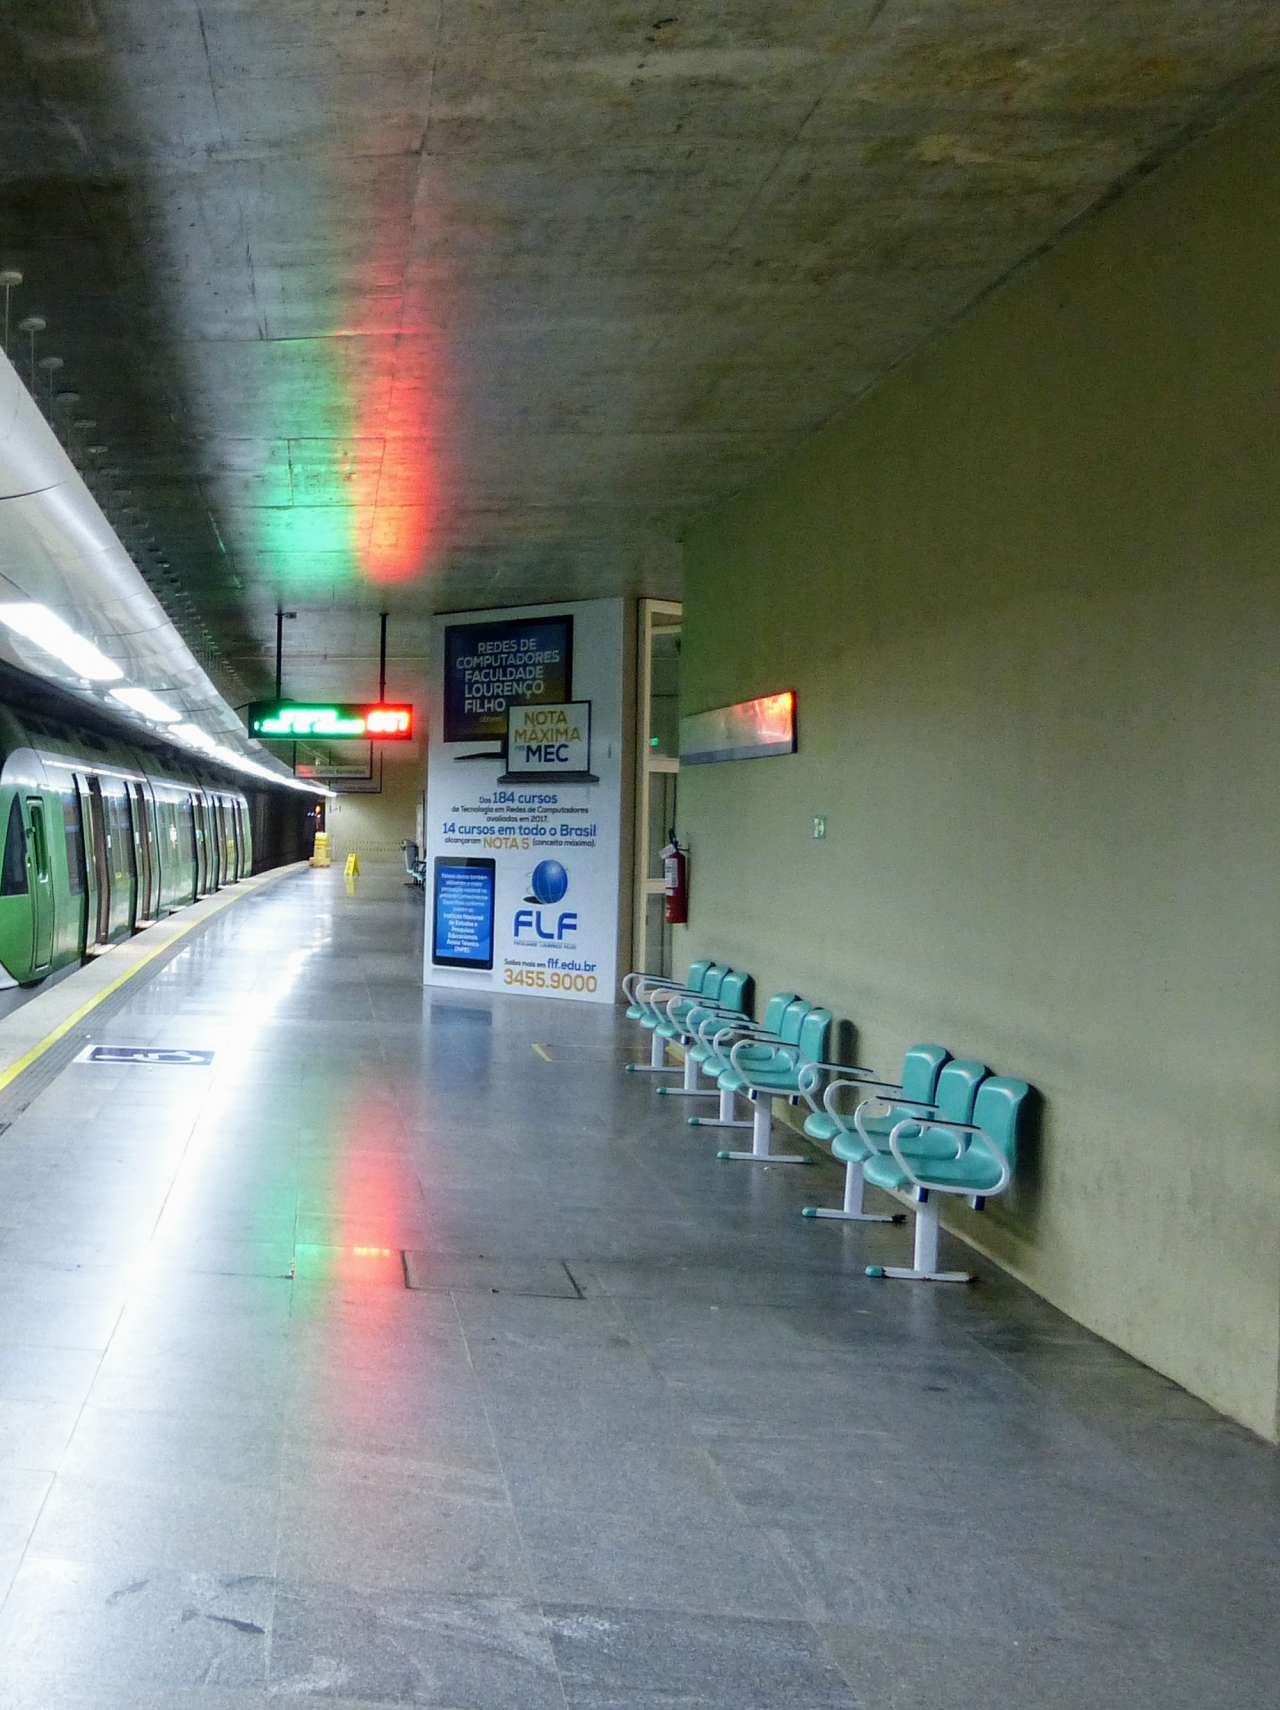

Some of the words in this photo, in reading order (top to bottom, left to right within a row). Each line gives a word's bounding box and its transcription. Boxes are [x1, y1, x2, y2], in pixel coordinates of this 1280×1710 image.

[477, 640, 518, 654] REDES
[520, 638, 537, 651] DE
[455, 650, 560, 669] COMPUTADORES
[464, 665, 545, 682] FACULDADE
[464, 680, 544, 699] LOURENÇO
[464, 698, 506, 713] FILHO
[524, 710, 568, 725] NOTA
[526, 744, 569, 763] MEC
[493, 791, 515, 804] 184
[518, 794, 558, 804] cursos
[461, 805, 494, 815] Tecnologia
[537, 806, 589, 815] Computadores
[442, 822, 456, 834] 14
[458, 825, 495, 835] cursos
[497, 826, 516, 836] em
[518, 824, 546, 837] todo
[549, 827, 557, 837] o
[560, 824, 597, 837] Brasil
[483, 836, 519, 849] NOTA
[521, 837, 530, 849] 5
[513, 910, 578, 941] FLF
[547, 958, 597, 972] flf.edu.br
[504, 967, 598, 993] 3455.9000
